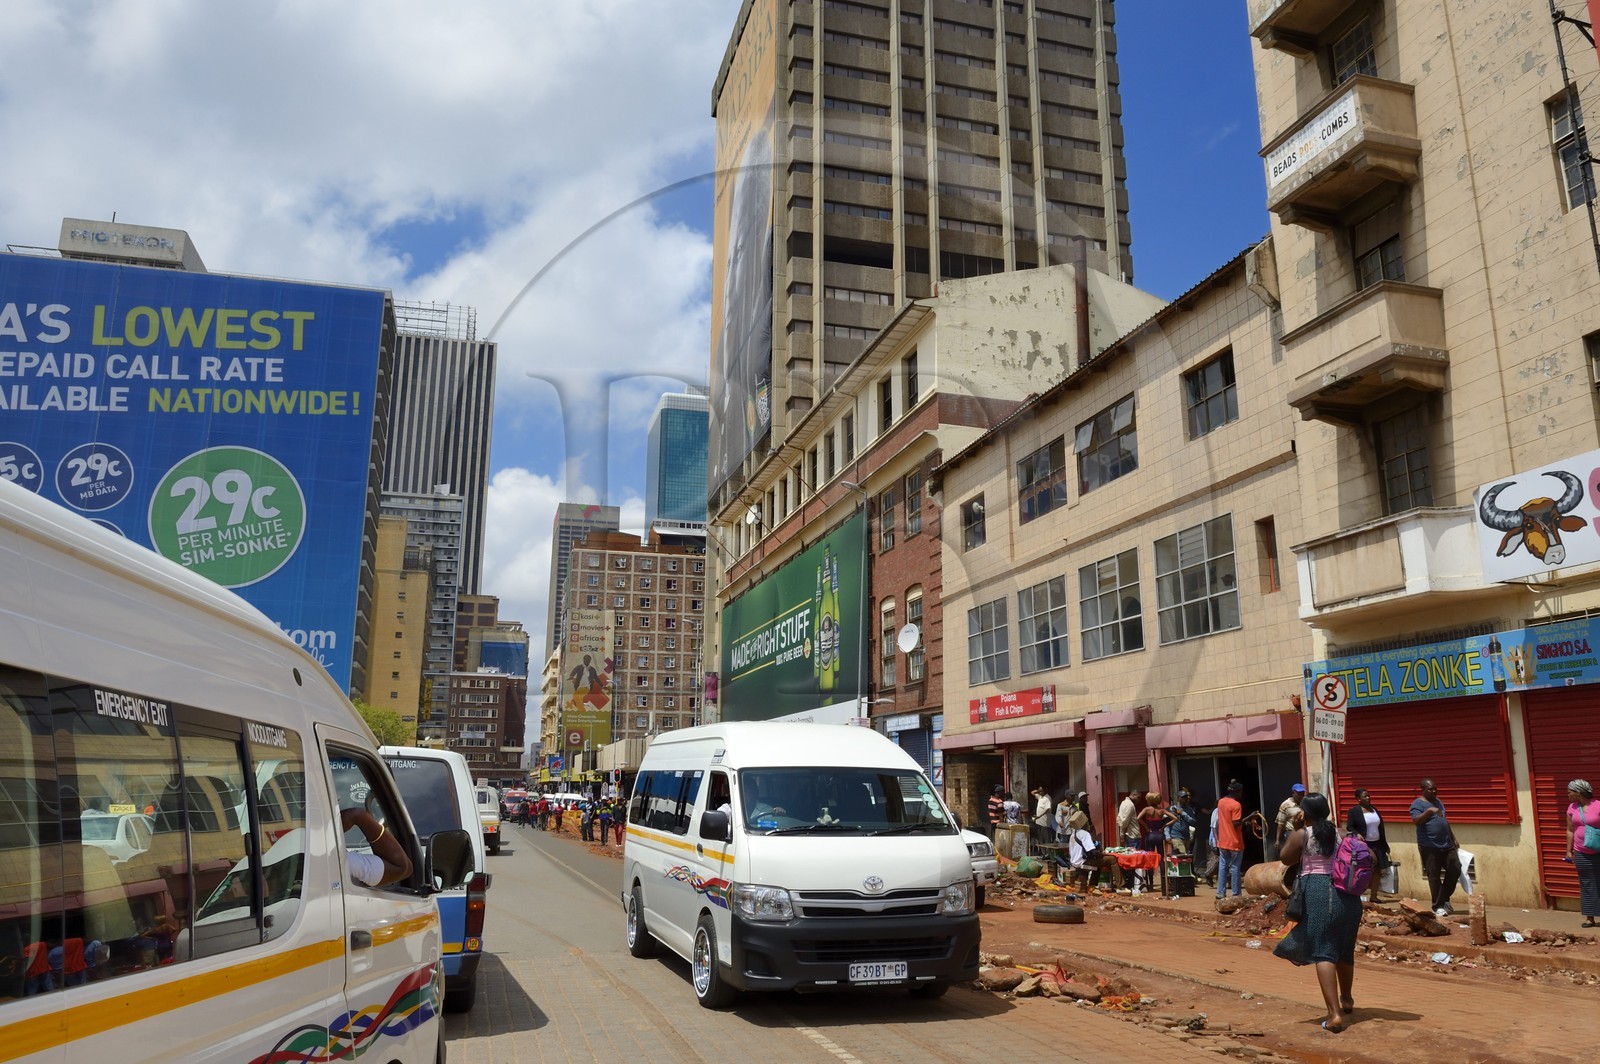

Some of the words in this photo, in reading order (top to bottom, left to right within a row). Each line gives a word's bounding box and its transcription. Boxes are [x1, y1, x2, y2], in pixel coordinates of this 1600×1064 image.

[717, 9, 774, 164] MADIBA
[1273, 151, 1297, 178] BEADS
[91, 305, 315, 351] LOWEST
[106, 354, 189, 381] CALL
[200, 356, 284, 382] RATE
[67, 453, 123, 486] 29c
[80, 490, 95, 500] MB
[96, 485, 118, 496] DATA
[89, 481, 105, 491] PER
[170, 468, 281, 535] 29c
[178, 533, 213, 550] PER
[218, 518, 285, 543] MINUTE
[731, 639, 750, 672] MADE
[757, 623, 780, 660] RIGHT
[780, 608, 811, 649] STUFF
[793, 644, 804, 659] BEER
[1330, 658, 1349, 669] Things
[1350, 657, 1361, 666] are
[1361, 654, 1374, 664] bad
[1375, 652, 1381, 663] &
[1382, 647, 1417, 661] everything
[1419, 645, 1436, 658] goes
[1437, 640, 1461, 653] wrong
[1398, 651, 1484, 695] ZONKE
[94, 689, 150, 724] EMERGENCY
[150, 701, 168, 727] EXIT
[995, 706, 1005, 717] Fish
[1009, 704, 1024, 716] Chips
[1000, 693, 1017, 703] Polana
[247, 722, 287, 749] NOODUITGANG
[894, 963, 906, 977] GP
